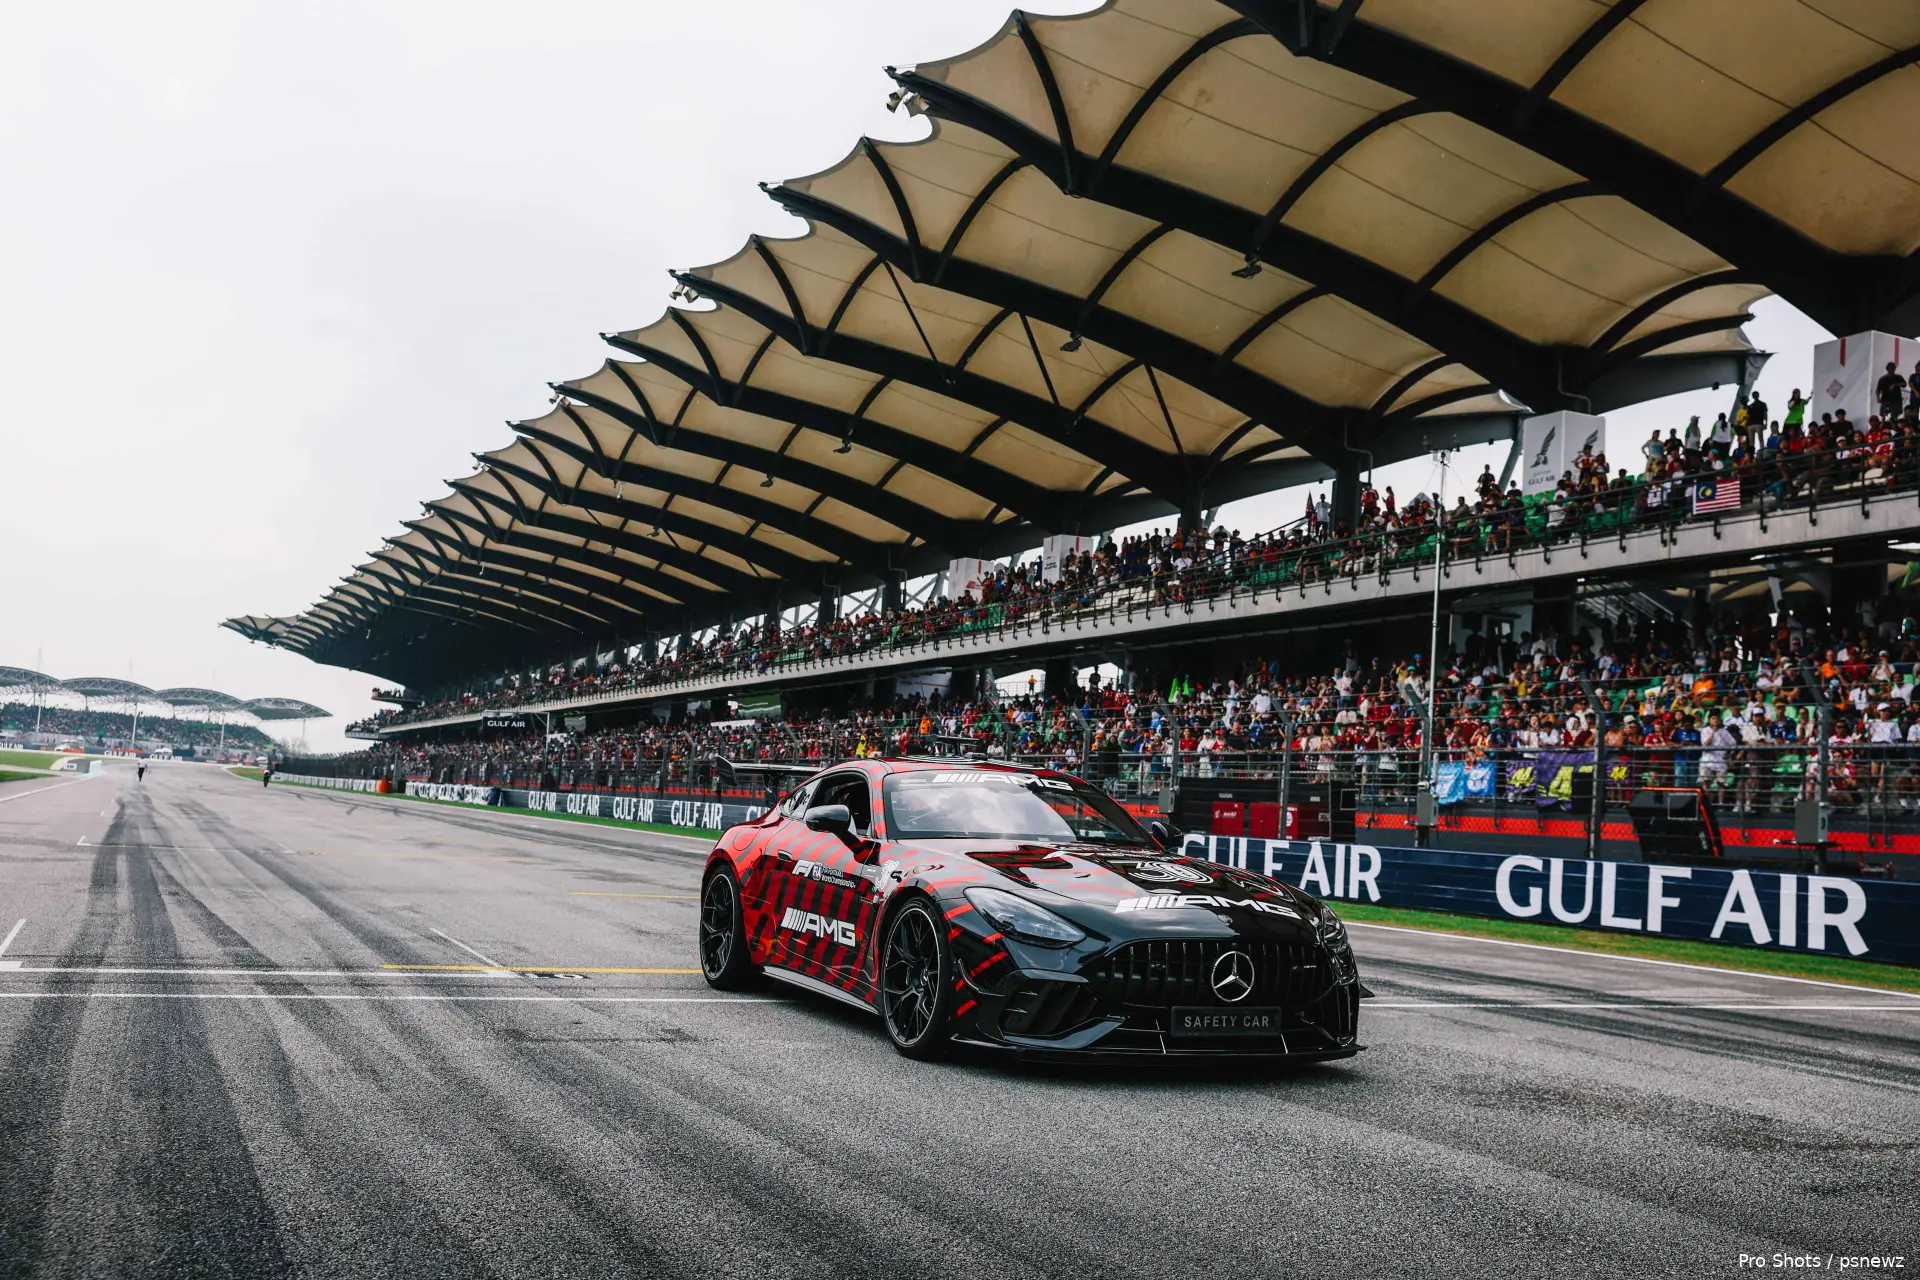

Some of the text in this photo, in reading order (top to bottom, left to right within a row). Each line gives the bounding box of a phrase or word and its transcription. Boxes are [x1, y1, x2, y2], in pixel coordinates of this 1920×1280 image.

[974, 774, 1073, 791] AMG
[528, 791, 556, 811] GULF AIR
[567, 793, 600, 816] GULF AIR
[613, 797, 654, 822] GULF AIR
[671, 801, 700, 826] GULF
[701, 803, 722, 829] AIR
[1300, 842, 1381, 902] AIR
[1168, 895, 1301, 920] AMG
[1495, 855, 1869, 956] GULF AIR
[801, 912, 856, 947] AMG
[1184, 1016, 1269, 1027] SAFETY CAR
